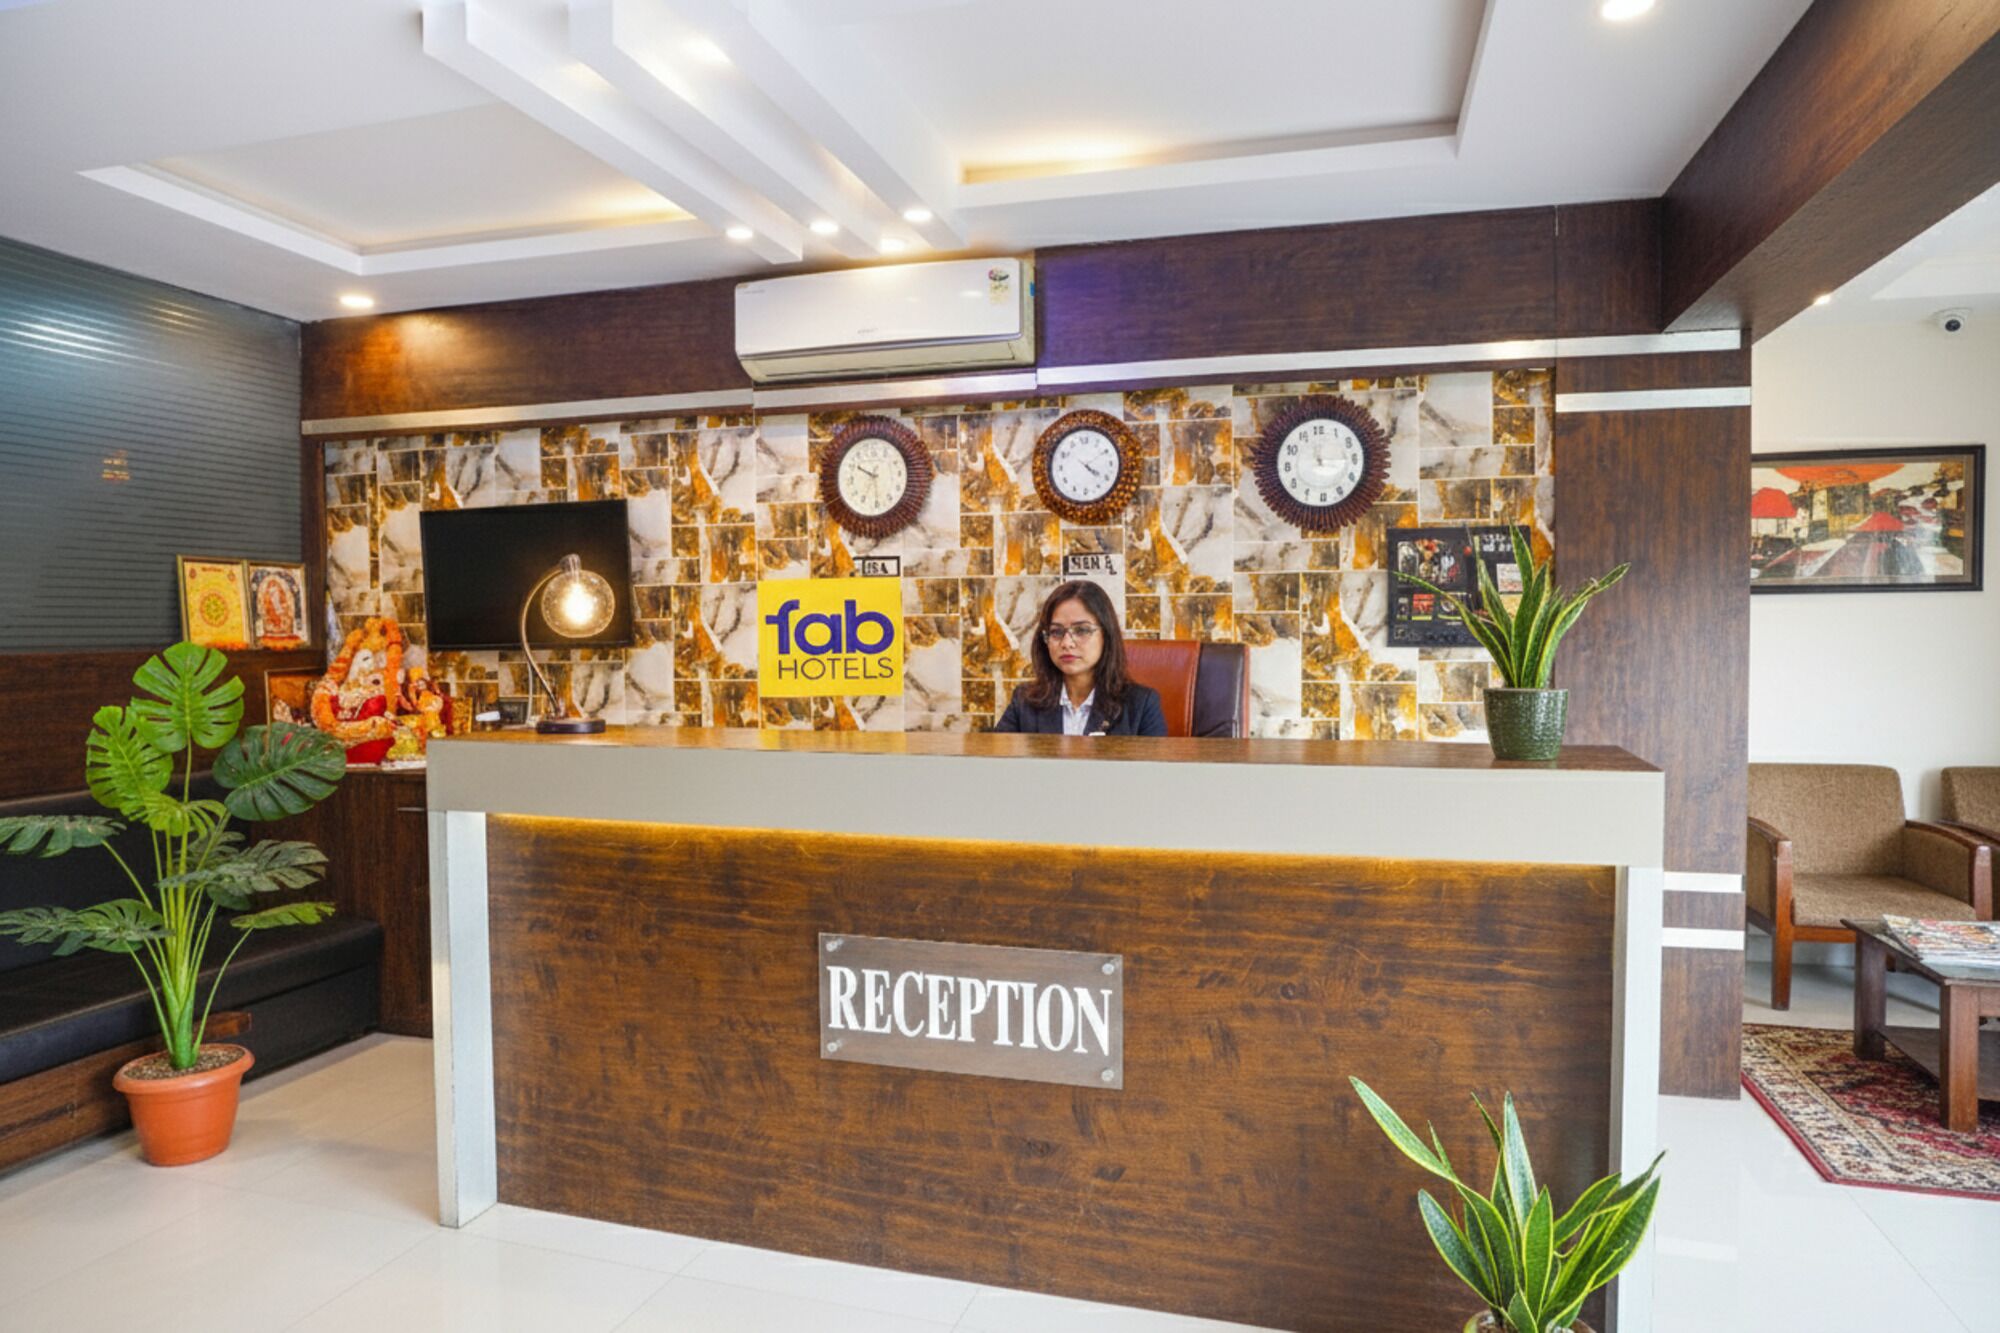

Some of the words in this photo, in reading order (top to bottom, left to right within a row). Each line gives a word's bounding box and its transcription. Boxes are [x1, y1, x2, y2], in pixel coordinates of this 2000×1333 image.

[765, 599, 895, 655] fab
[778, 657, 894, 680] HOTELS
[826, 965, 1113, 1056] RECEPTION
